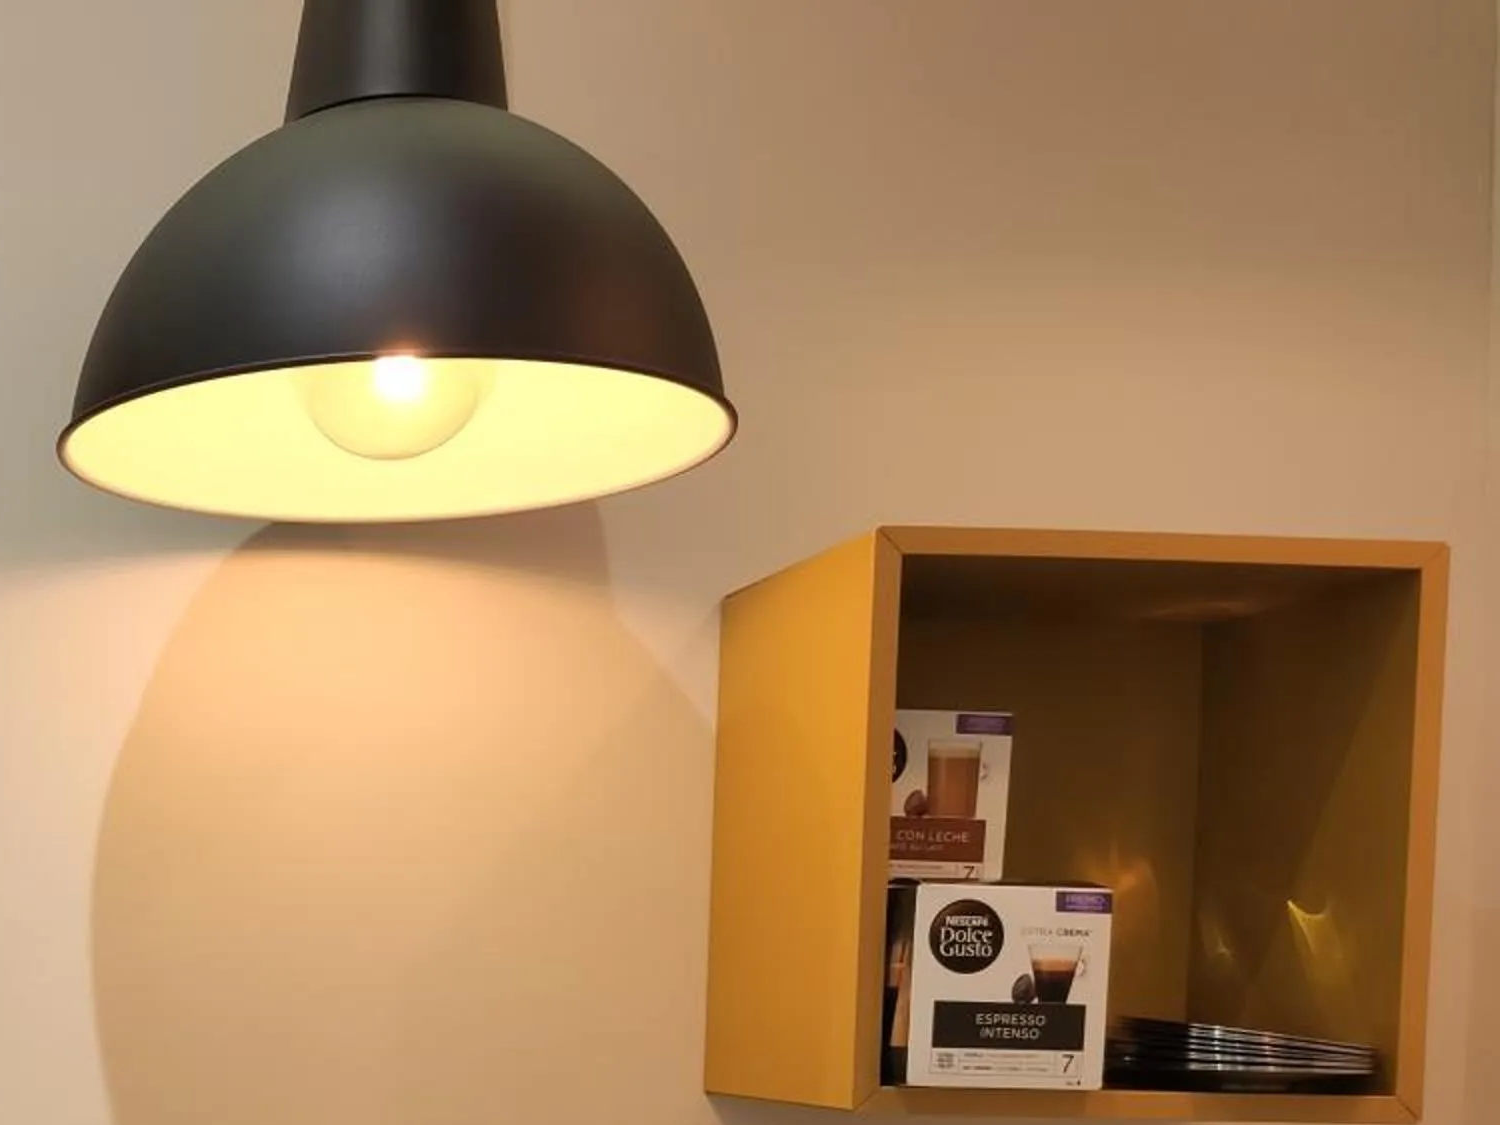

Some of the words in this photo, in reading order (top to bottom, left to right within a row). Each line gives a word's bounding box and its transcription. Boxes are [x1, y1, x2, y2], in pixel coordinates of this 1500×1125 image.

[928, 830, 969, 844] LECHE
[941, 926, 993, 943] Dolce
[940, 941, 993, 958] Gusto
[975, 1013, 1047, 1027] ESPRESSO
[980, 1027, 1040, 1040] INTENSO
[1061, 1053, 1075, 1074] 7
